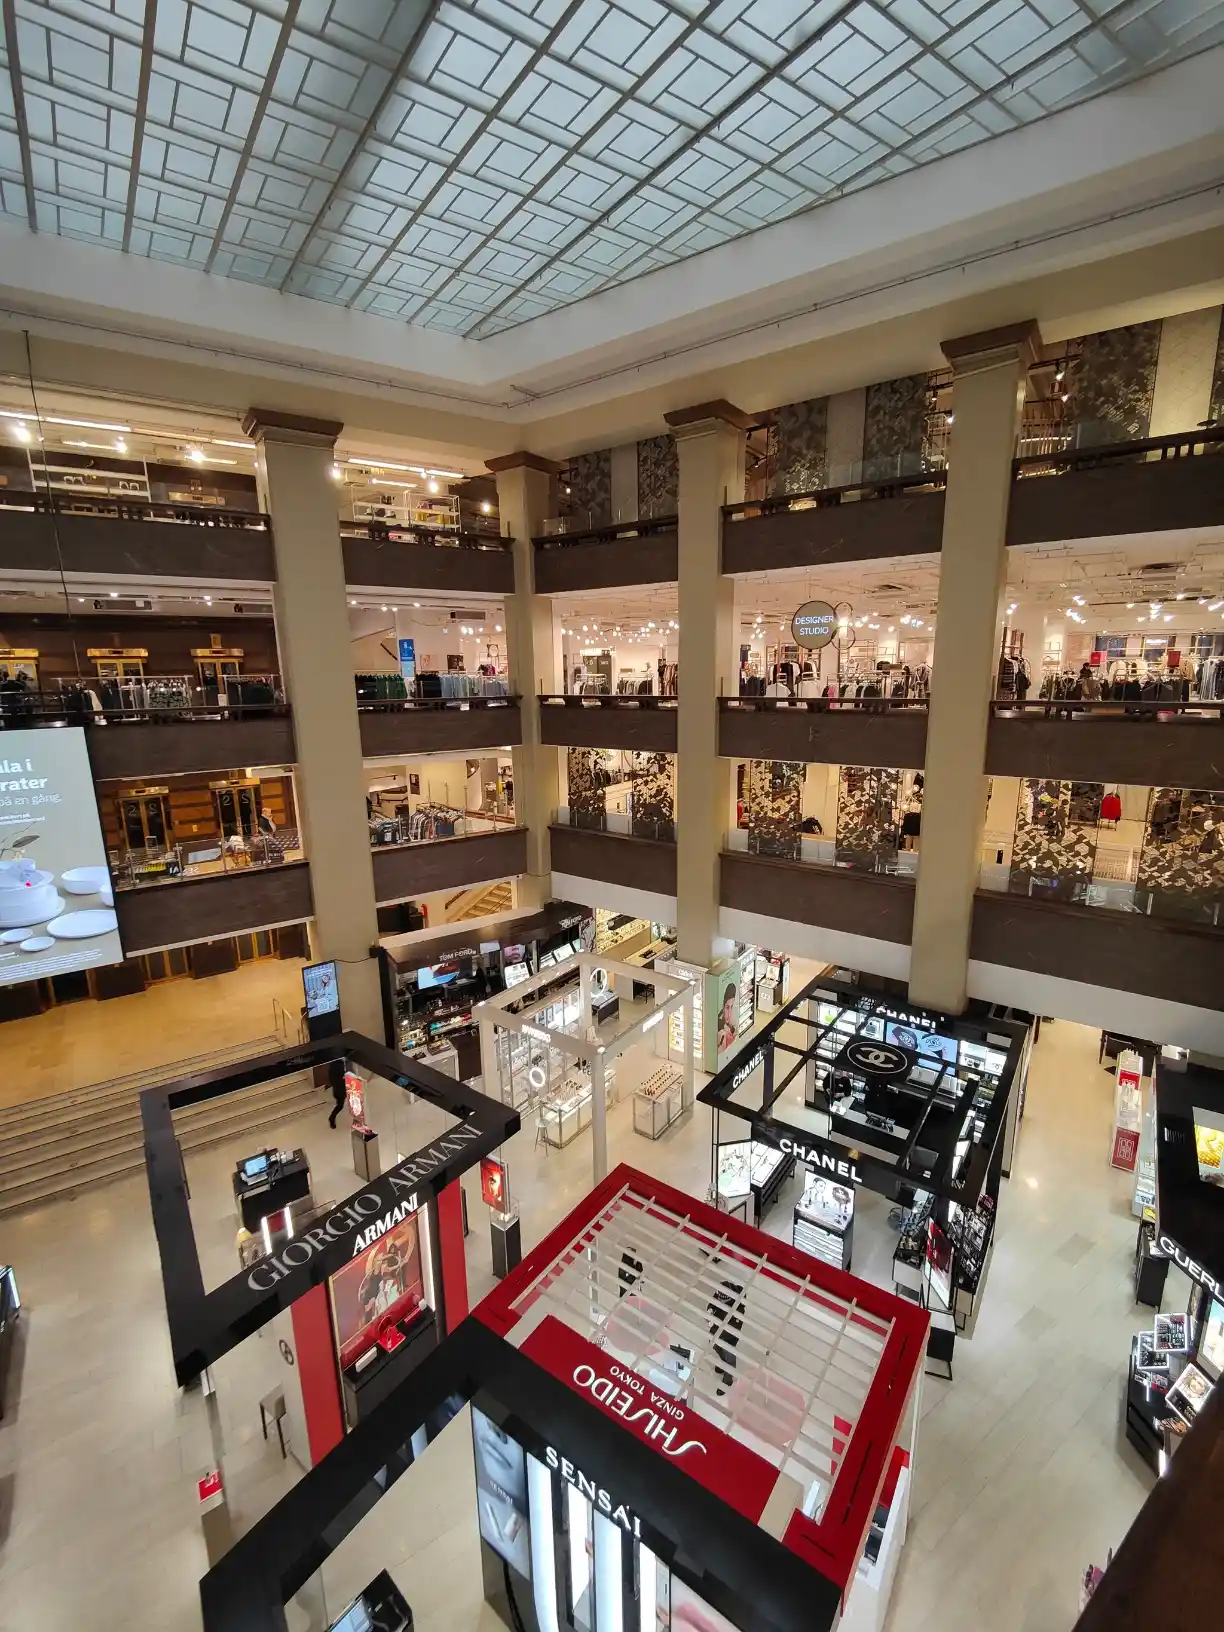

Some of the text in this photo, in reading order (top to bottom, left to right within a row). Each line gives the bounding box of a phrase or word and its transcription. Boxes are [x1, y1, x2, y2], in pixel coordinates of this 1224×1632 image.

[795, 616, 834, 625] DESIGNER
[799, 627, 829, 636] STUDIO
[0, 758, 34, 774] la i
[732, 1051, 765, 1089] CHANEL
[779, 1139, 863, 1183] CHANEL
[247, 1123, 484, 1291] GIORGIO ARMANI
[352, 1192, 419, 1257] ARMANI
[1159, 1236, 1224, 1303] GUERL
[573, 1365, 707, 1455] SHISEIDO
[610, 1366, 685, 1421] GINZA TOKYO
[546, 1446, 641, 1538] SENSAI
